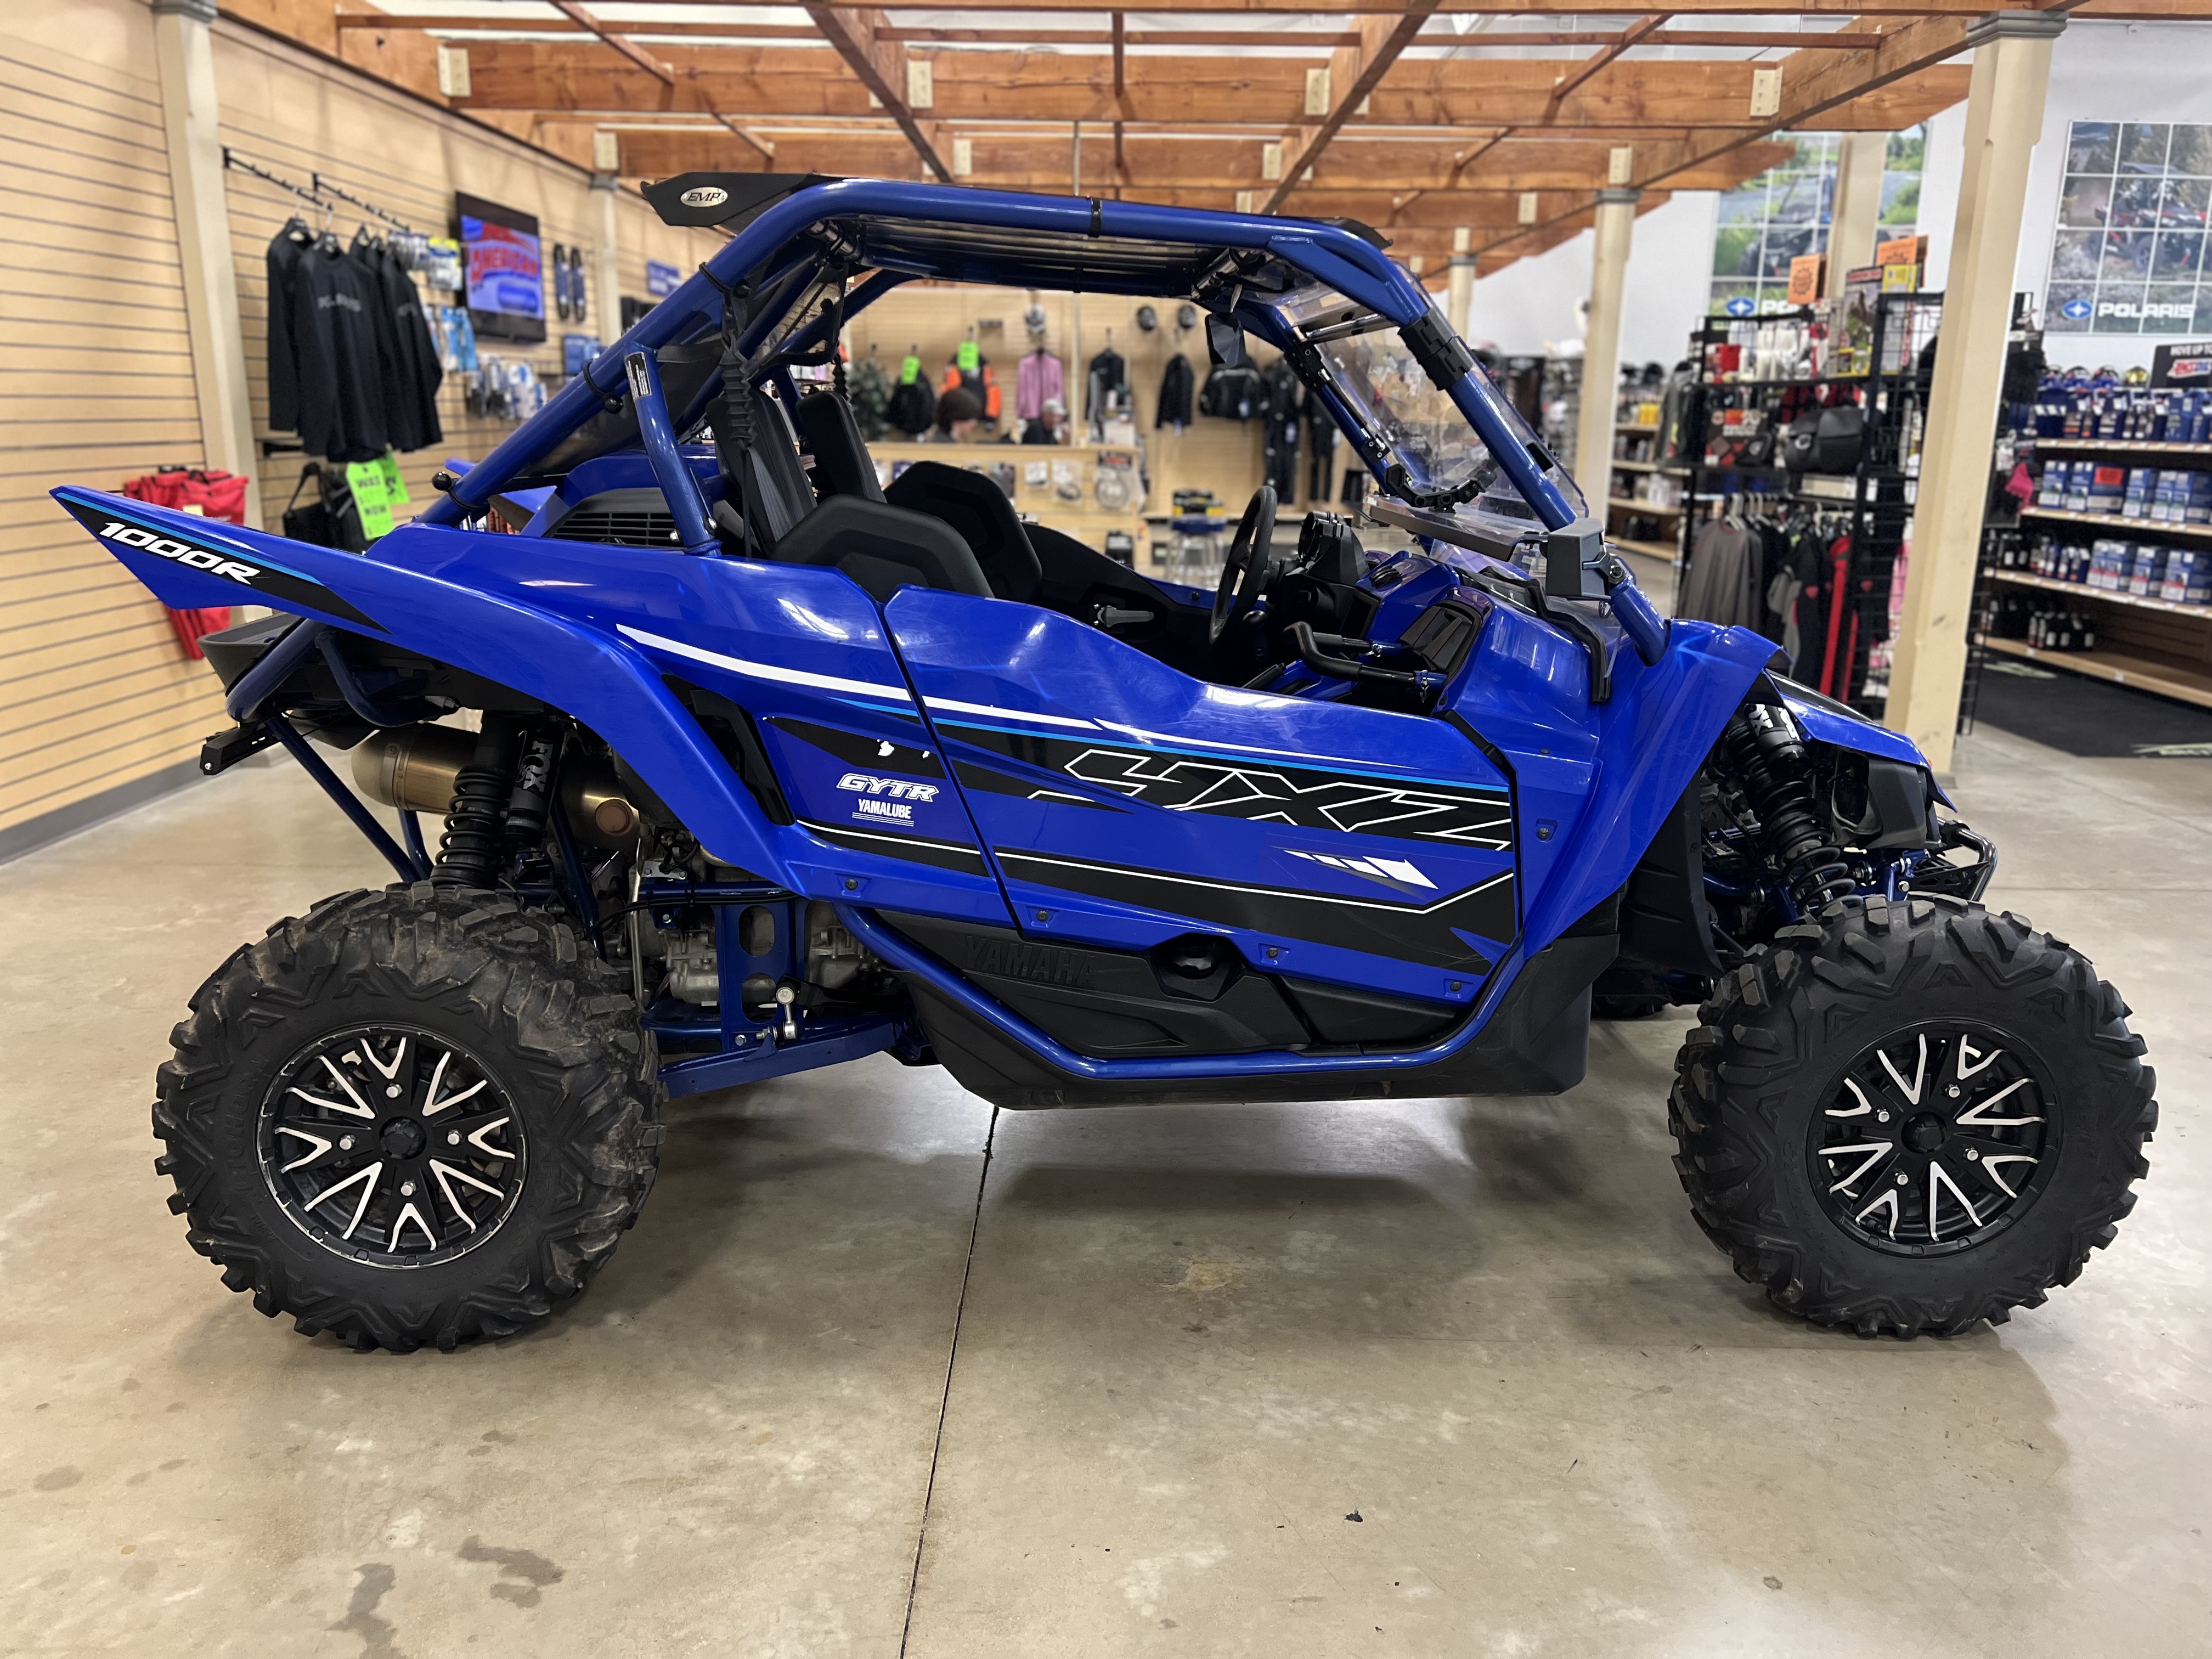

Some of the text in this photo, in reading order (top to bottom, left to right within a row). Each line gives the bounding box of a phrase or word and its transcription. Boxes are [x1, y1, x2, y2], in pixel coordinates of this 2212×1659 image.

[687, 192, 721, 201] EMP
[2098, 303, 2196, 318] POLARIS
[99, 522, 261, 585] 1000R
[517, 741, 554, 793] FOX
[836, 772, 939, 802] GYTR
[858, 798, 912, 819] YAMALUBE
[966, 935, 1096, 988] YAMAHA
